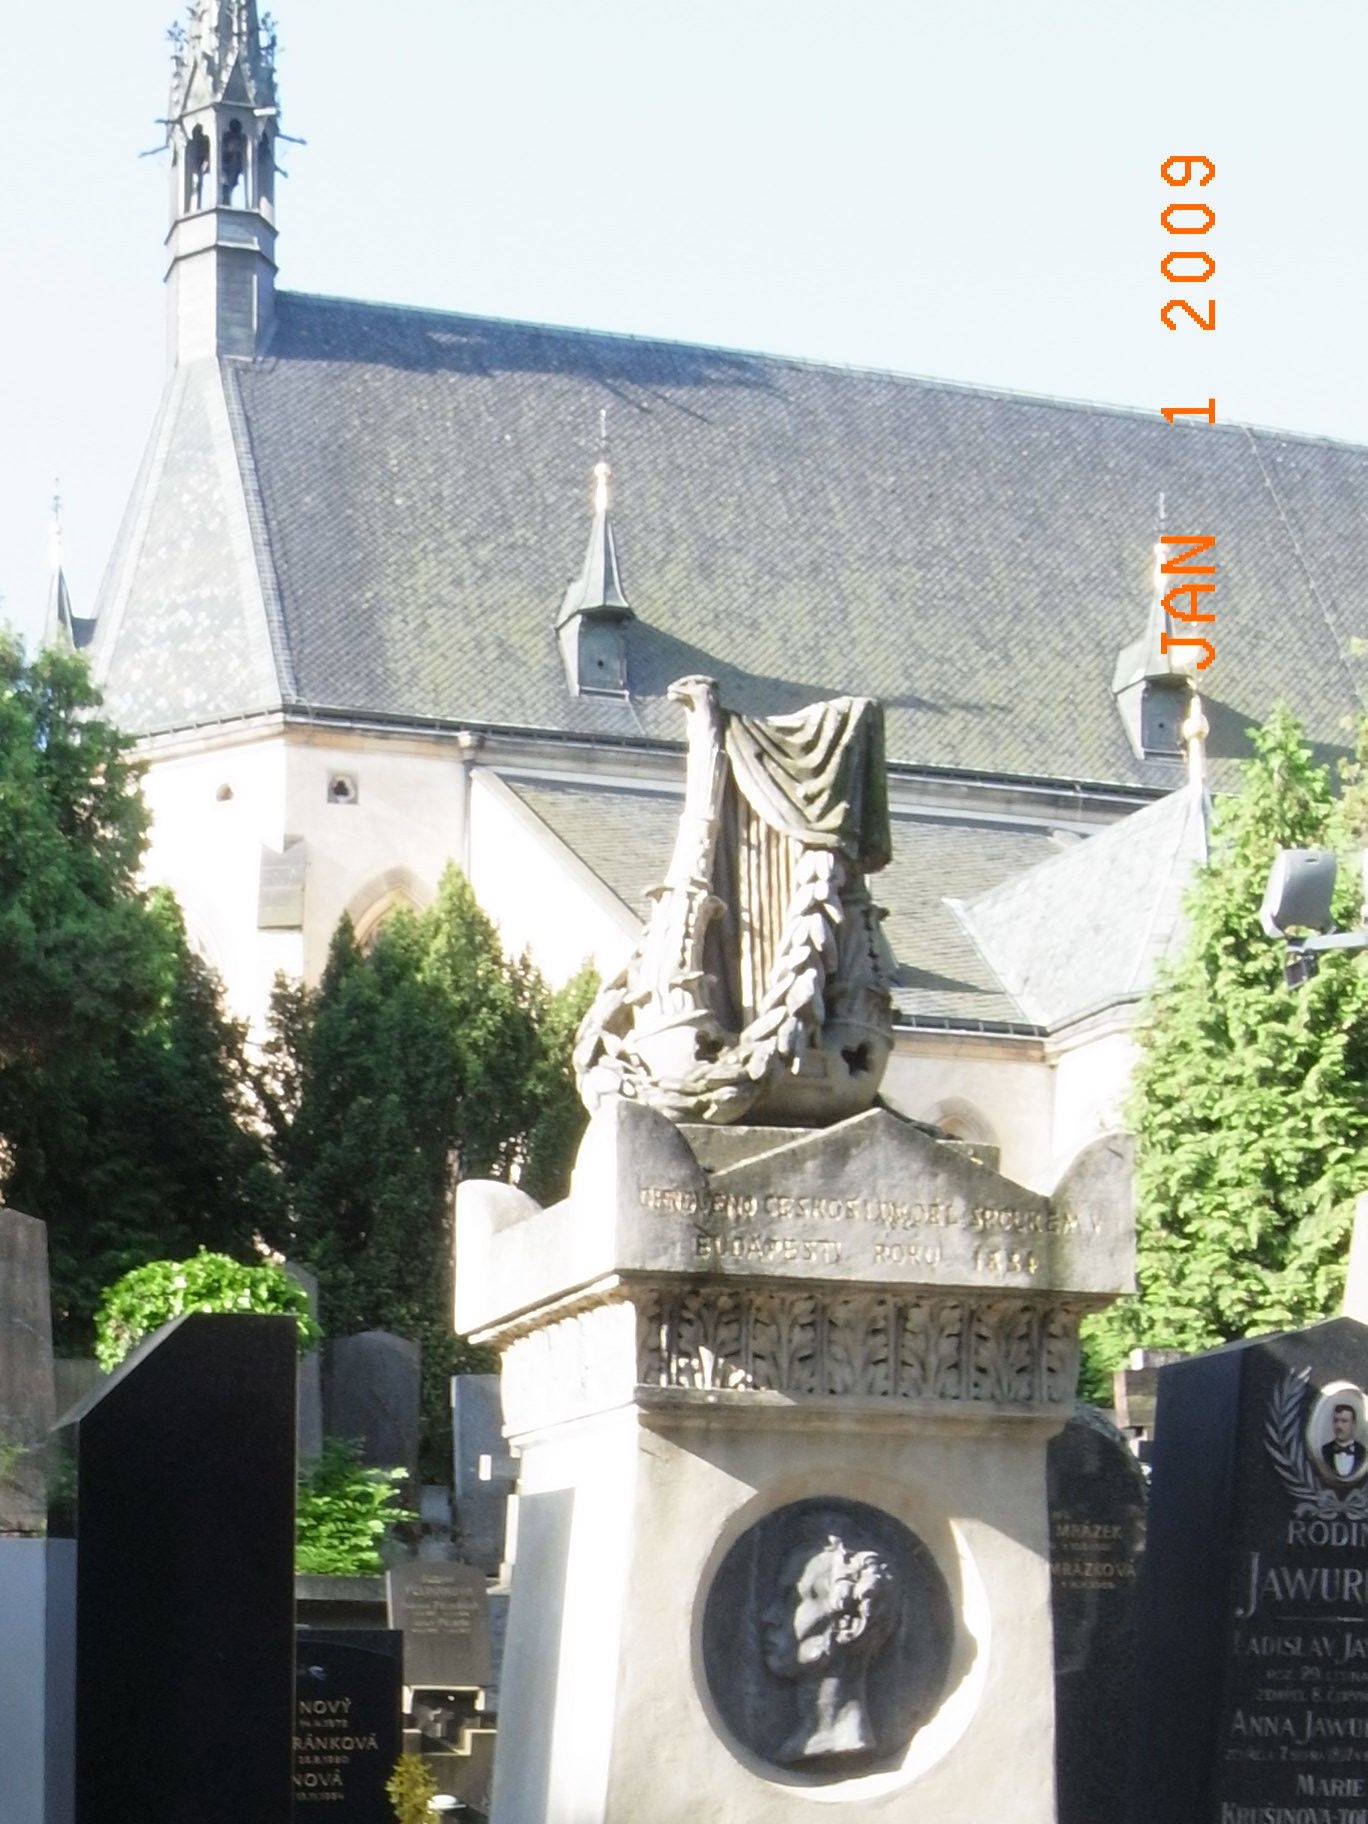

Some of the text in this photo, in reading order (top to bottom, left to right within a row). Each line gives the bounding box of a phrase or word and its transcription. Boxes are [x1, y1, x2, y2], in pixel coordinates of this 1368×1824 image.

[1233, 1549, 1368, 1619] JAWUR
[299, 1697, 352, 1715] NOVÝ
[1231, 1708, 1295, 1738] ANNA
[1296, 1773, 1365, 1798] MARIE
